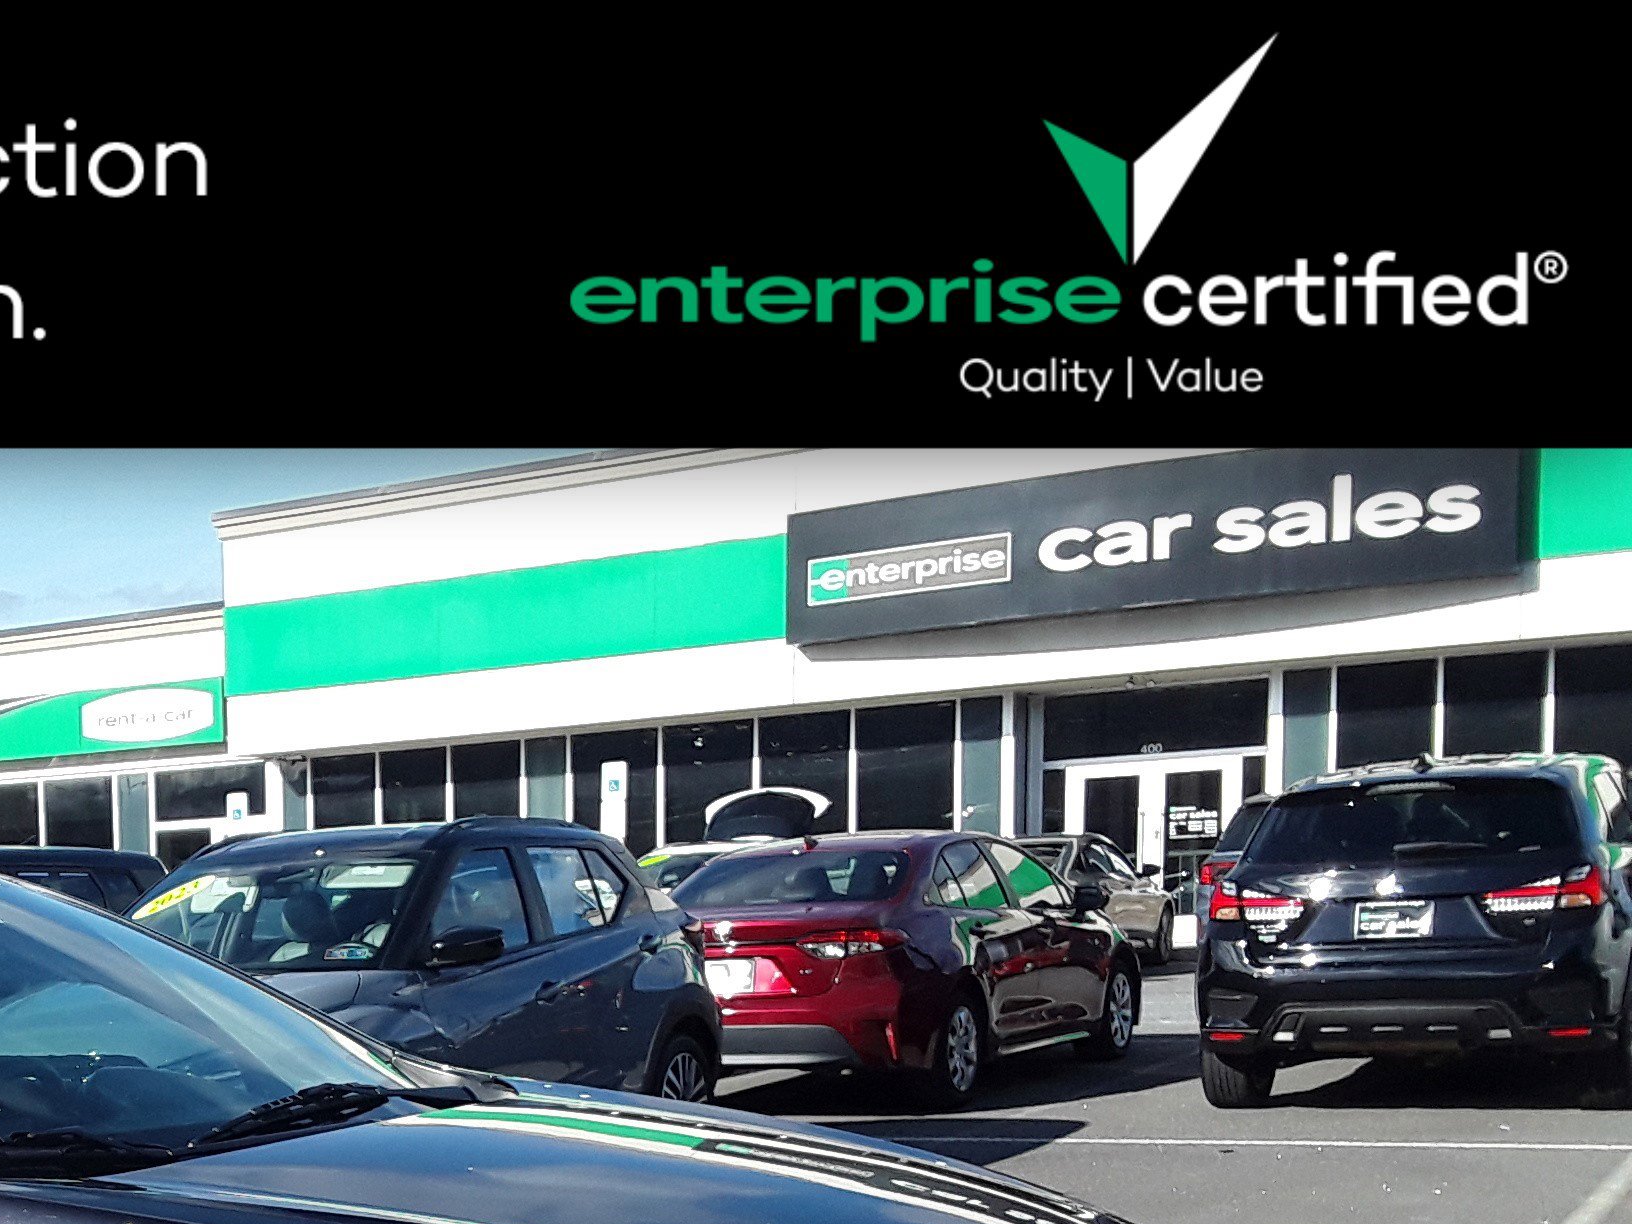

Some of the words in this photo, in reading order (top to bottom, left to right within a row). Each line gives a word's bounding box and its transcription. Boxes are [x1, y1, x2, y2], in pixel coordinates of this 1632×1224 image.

[819, 547, 1006, 591] enterprise
[1037, 512, 1193, 572] car
[1212, 473, 1481, 554] sales
[1140, 743, 1163, 754] 400
